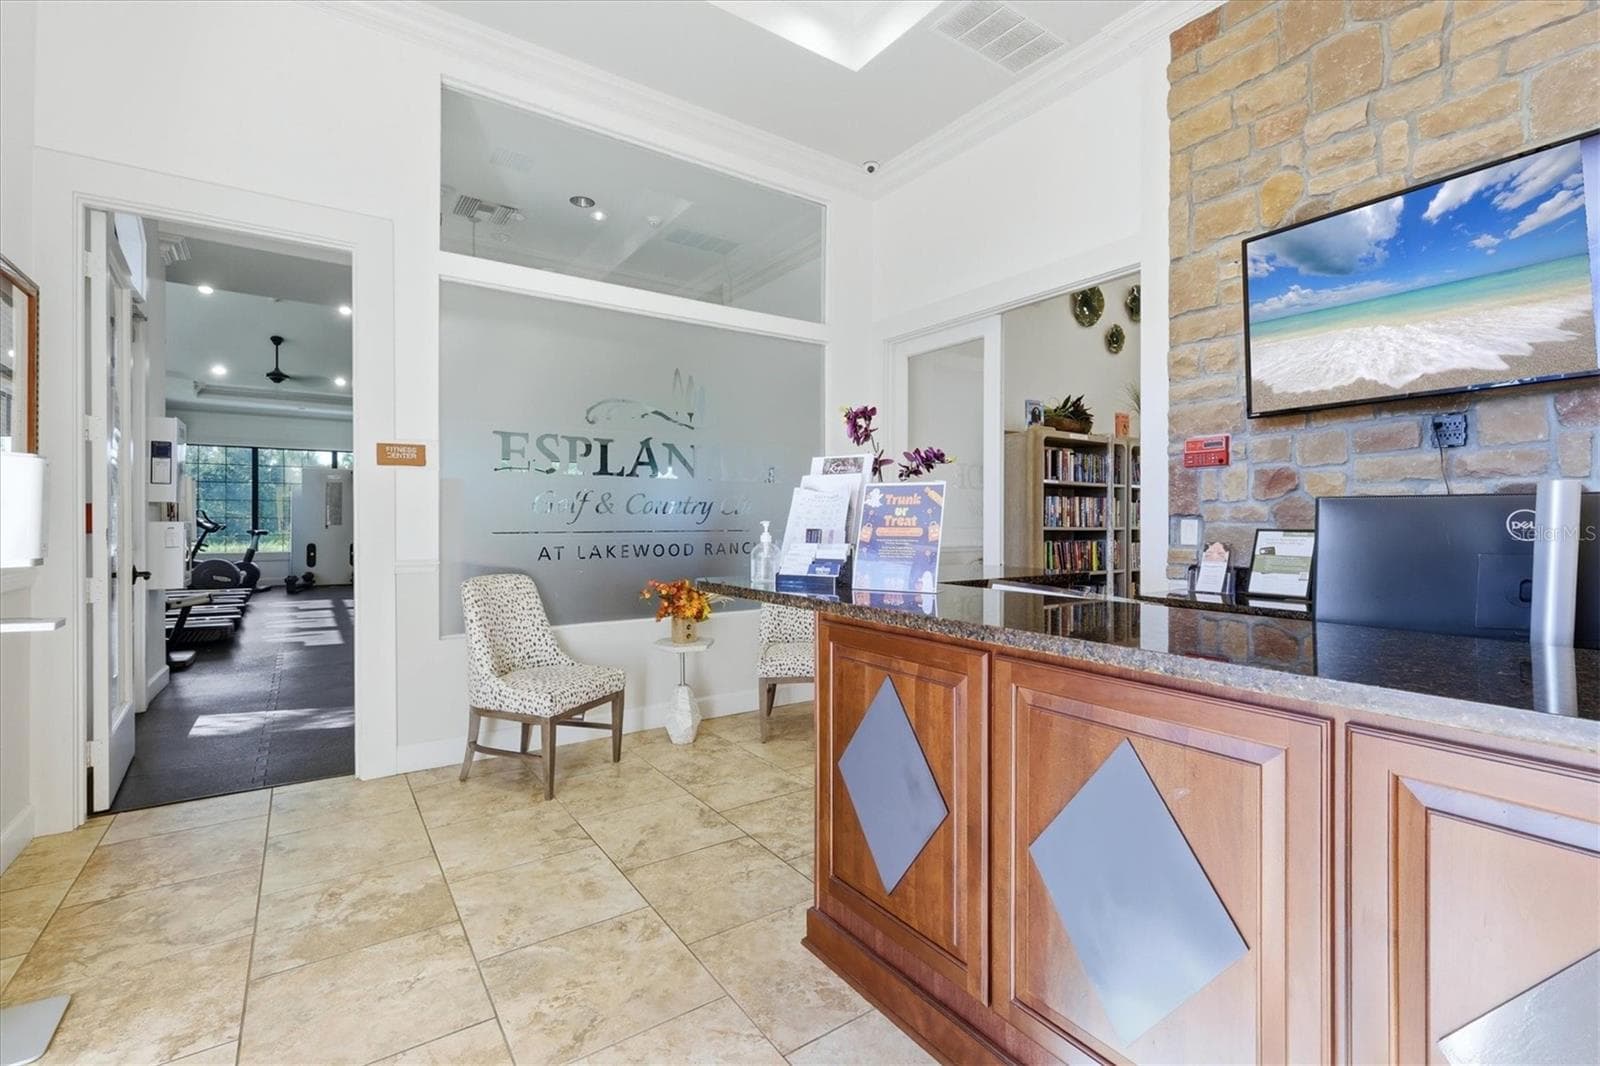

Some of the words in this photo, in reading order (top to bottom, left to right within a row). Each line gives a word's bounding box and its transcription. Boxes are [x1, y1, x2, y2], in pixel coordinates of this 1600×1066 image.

[885, 493, 922, 505] Trunk
[595, 492, 615, 515] &
[625, 493, 714, 525] Country
[895, 507, 909, 516] or
[884, 515, 918, 527] Treat
[1511, 521, 1536, 530] DEL
[538, 546, 565, 561] AT
[577, 543, 695, 560] LAKEWOOD
[704, 541, 757, 557] RANC
